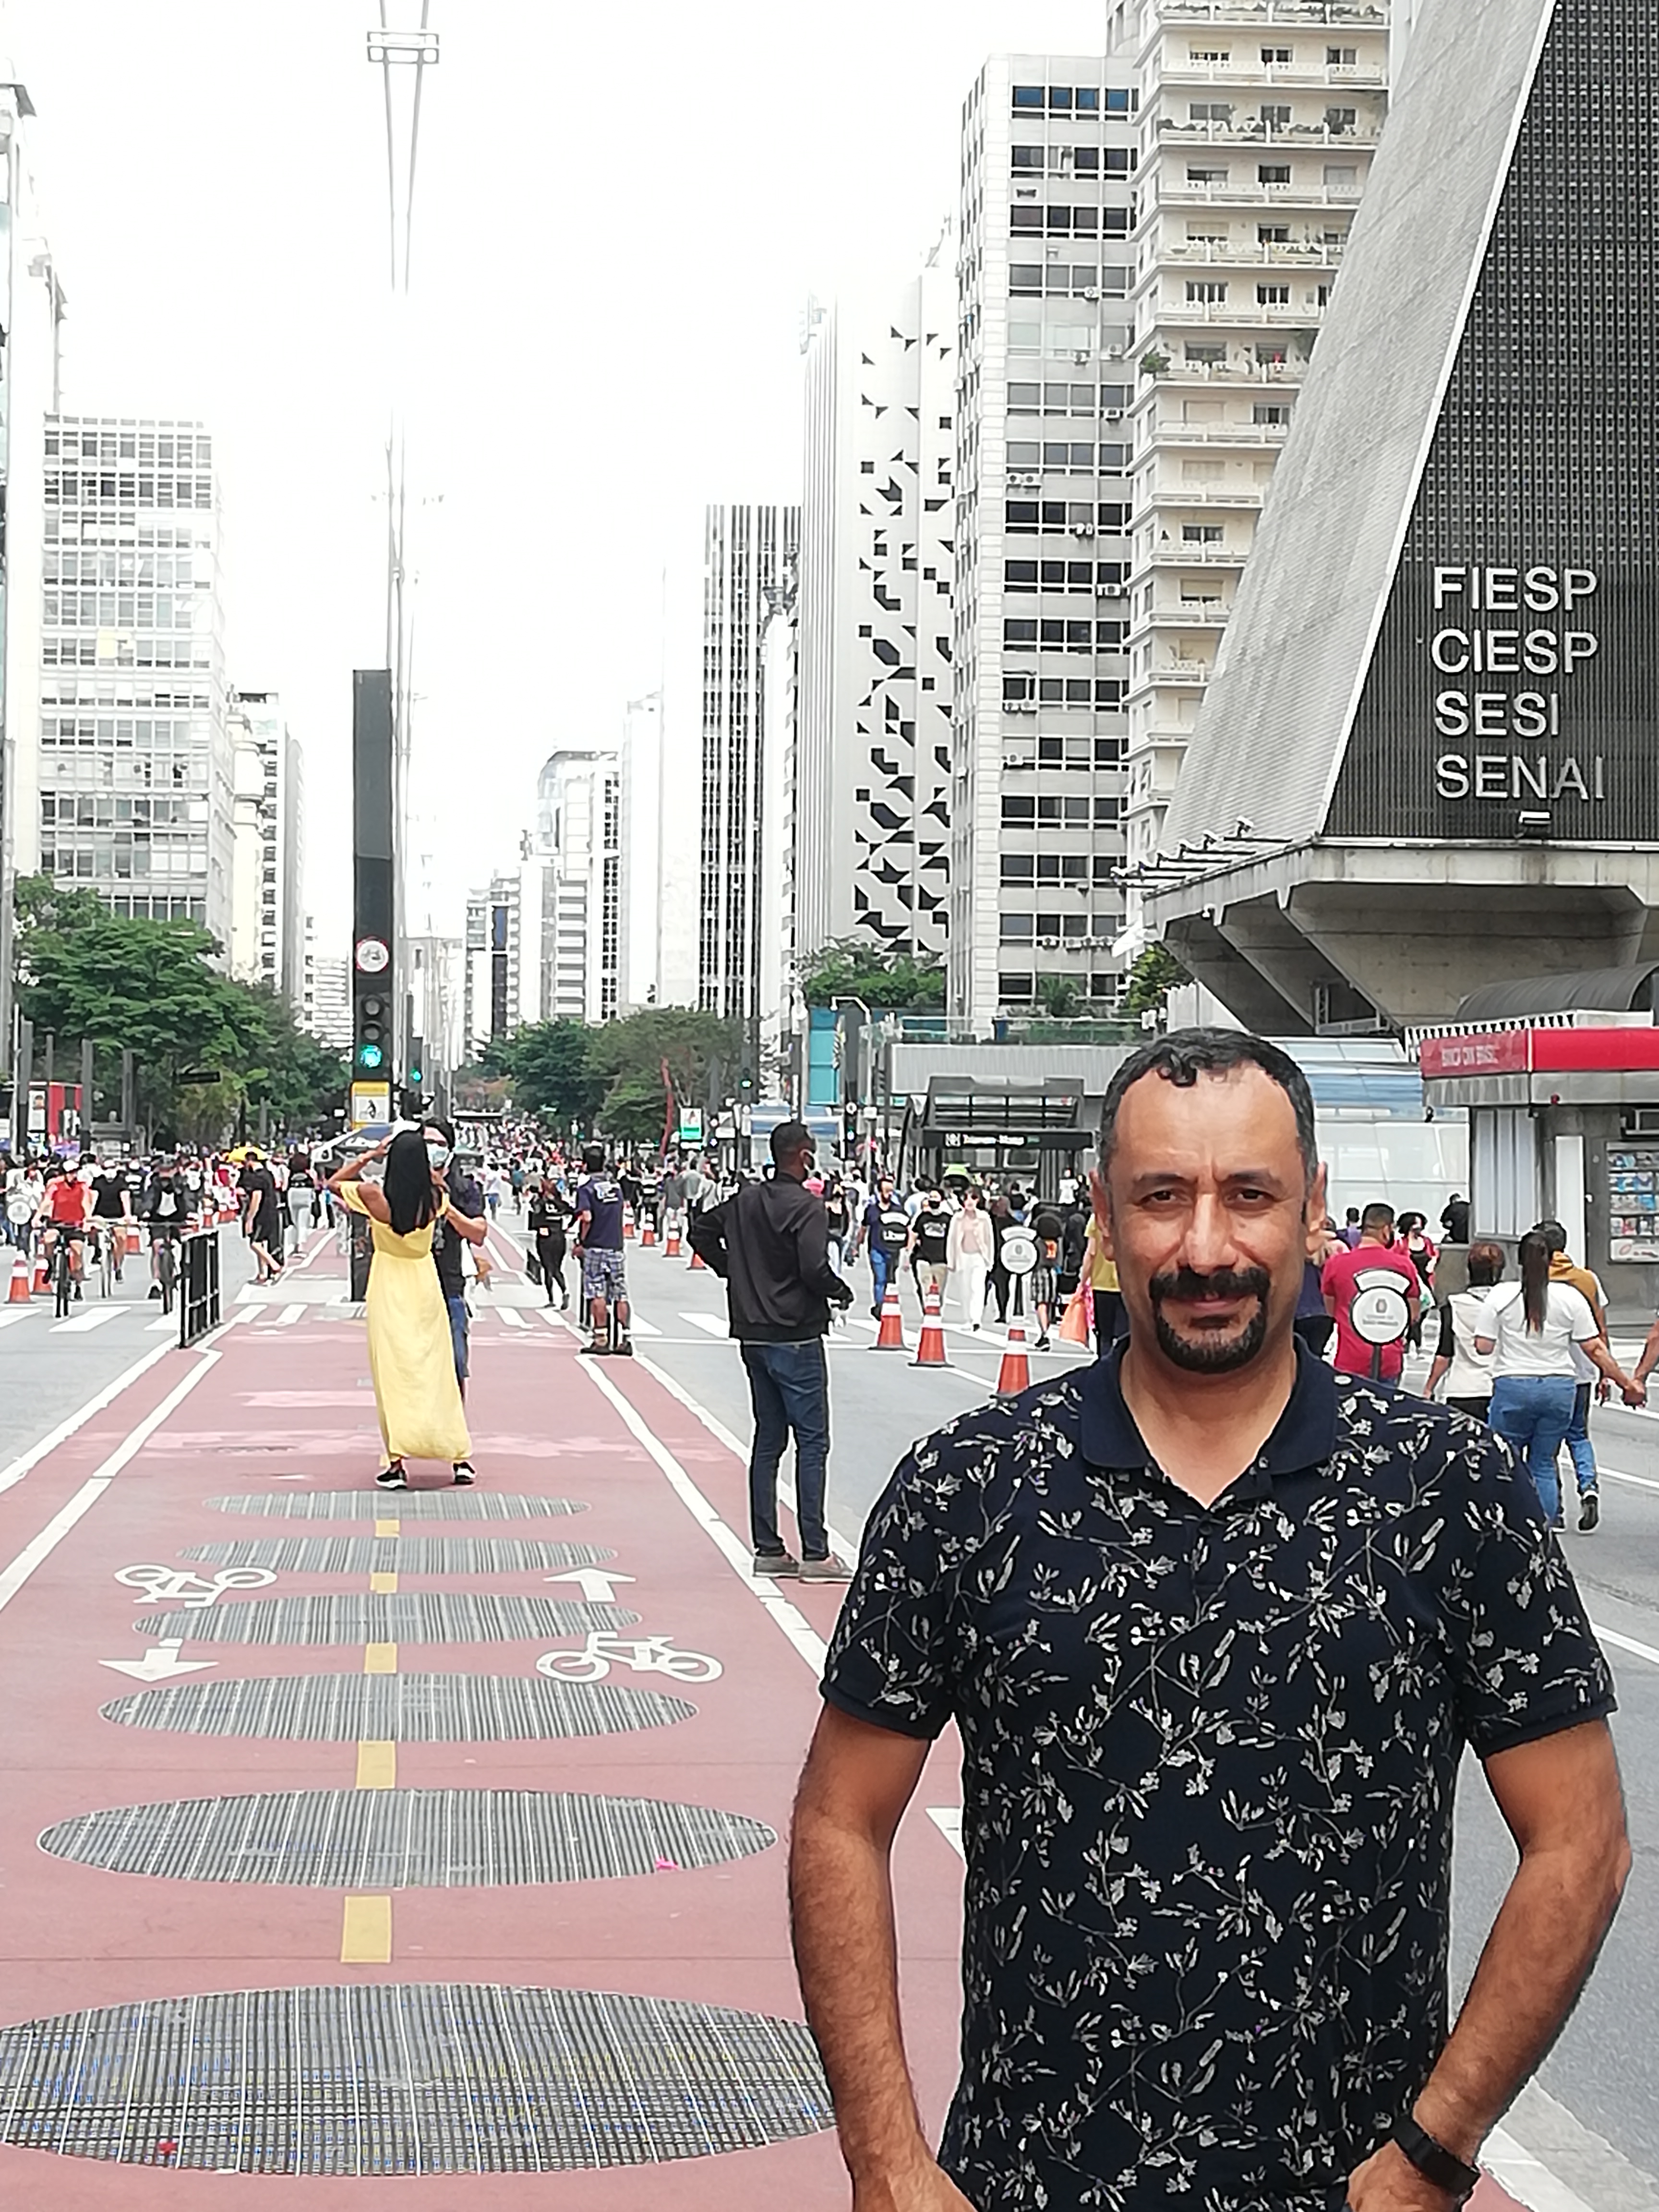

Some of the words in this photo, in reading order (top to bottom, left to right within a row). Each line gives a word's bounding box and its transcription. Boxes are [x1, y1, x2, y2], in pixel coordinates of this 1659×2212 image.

[1434, 566, 1598, 612] FIESP
[1431, 628, 1599, 674] CIESP
[1435, 690, 1559, 737] SESI
[1435, 754, 1605, 800] SENAI
